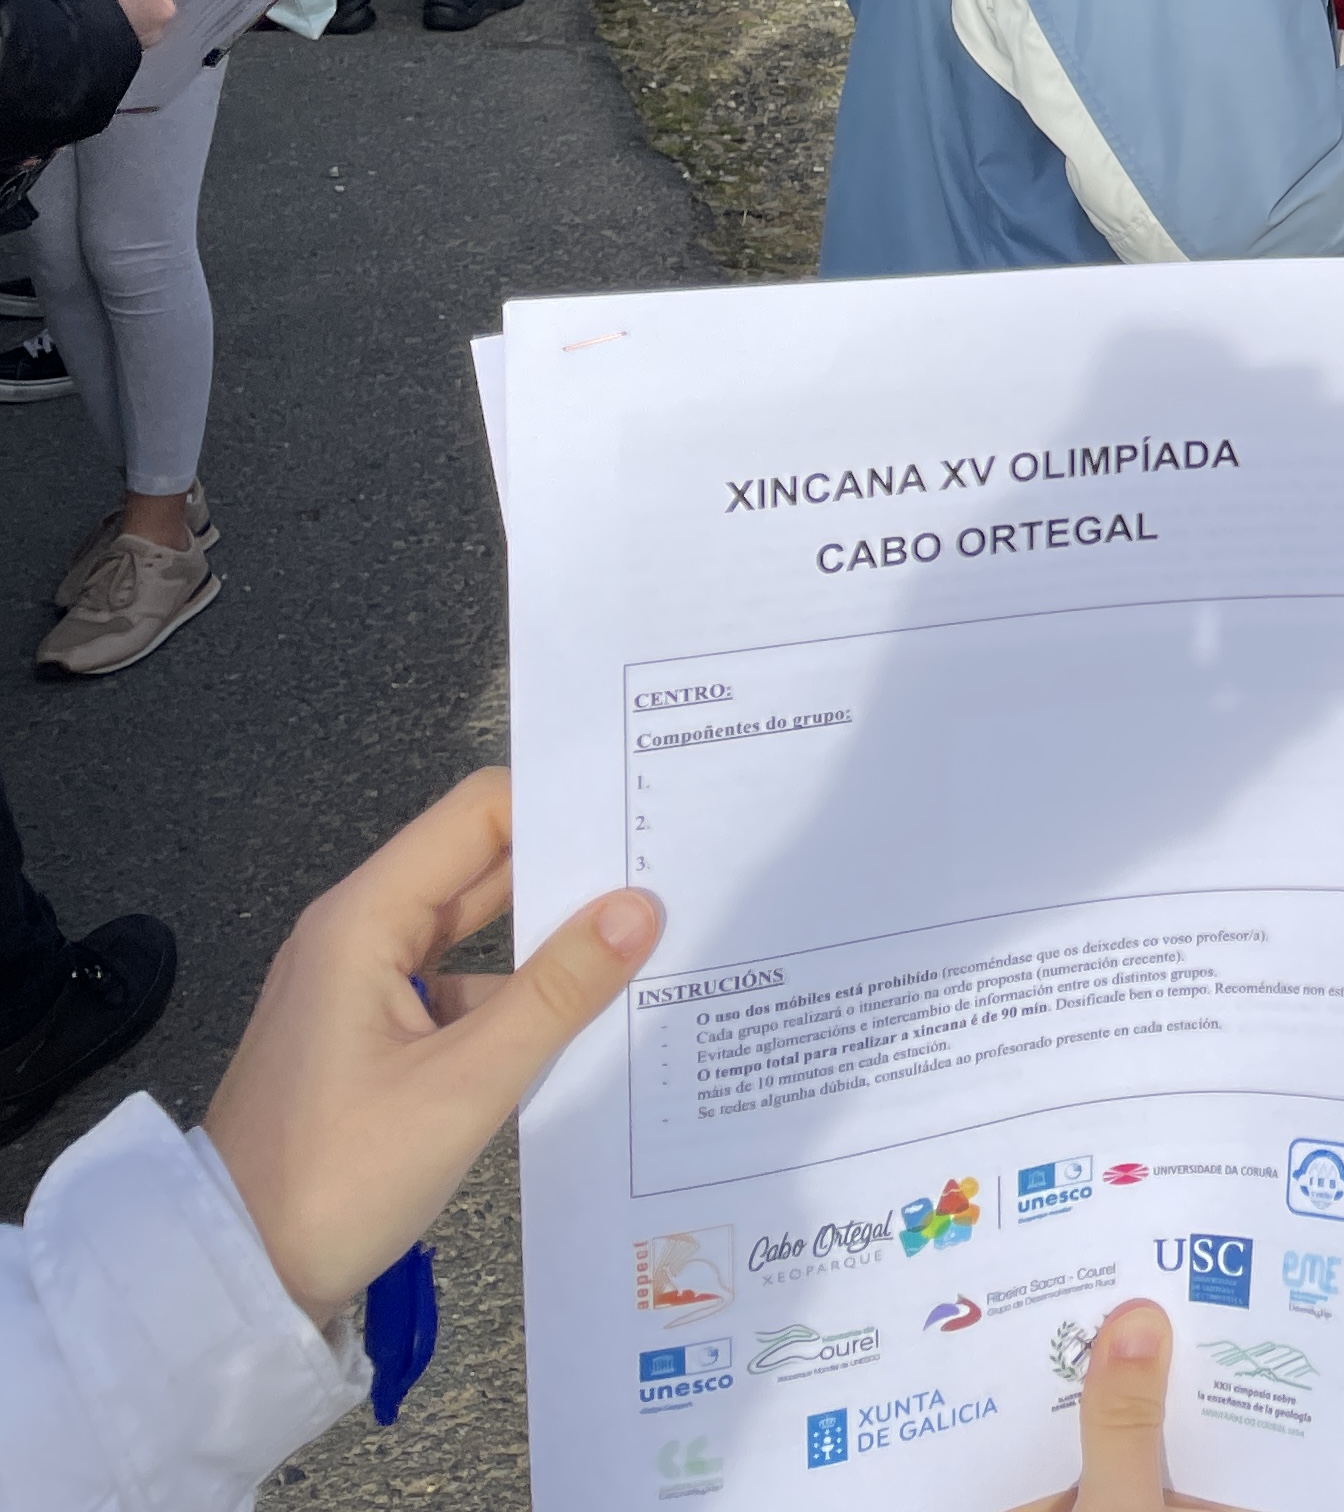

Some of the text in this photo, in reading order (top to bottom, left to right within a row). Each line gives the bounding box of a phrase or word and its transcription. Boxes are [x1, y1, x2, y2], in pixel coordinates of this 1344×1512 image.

[724, 435, 1240, 514] XINCANA XV OLIMPÍADA
[816, 512, 1159, 575] CABO ORTEGAL
[633, 683, 734, 710] CENTRO:
[636, 708, 852, 750] Compoñentes do grupo:
[637, 775, 650, 789] 1.
[635, 815, 651, 830] 2.
[636, 856, 651, 871] 3.
[638, 967, 784, 1006] INSTRUCIÓNS
[696, 929, 1269, 1025] O uso dos móbiles está prohibido (recoméndase que os deixedes co voso profesor/a).
[696, 951, 1185, 1044] Cada grupo realizará o itinerario na orde proposta (numeración crecente).
[697, 968, 1218, 1063] Evitade aglomeracións e intercambio de información entre os distintos grupos.
[696, 1068, 710, 1082] O
[715, 1062, 762, 1079] tempo
[766, 1051, 799, 1069] total
[803, 1046, 838, 1065] para
[842, 1033, 897, 1054] realizar
[900, 1032, 909, 1041] a
[913, 1018, 967, 1038] xincana
[970, 1014, 978, 1025] é
[981, 1011, 998, 1024] de
[1001, 1006, 1018, 1020] 90
[1055, 991, 1126, 1011] Dosificade
[1129, 988, 1151, 1001] ben
[1155, 990, 1164, 998] o
[1167, 987, 1211, 999] tempo.
[1214, 980, 1300, 995] Recoméndase
[1303, 986, 1325, 996] non
[697, 1106, 715, 1119] Se
[760, 1088, 816, 1108] algunha
[819, 1076, 870, 1096] dúbida,
[955, 1055, 972, 1065] ao
[975, 1035, 1053, 1064] profesorado
[1056, 1027, 1111, 1048] presente
[1113, 1026, 1130, 1037] en
[1133, 1020, 1163, 1034] cada
[1166, 1017, 1223, 1032] estación.
[697, 1039, 951, 1100] máis de 10 minutos en cada estación.
[1152, 1164, 1279, 1178] UNIVERSIDADE DA CORUÑA
[1017, 1186, 1093, 1213] unesco
[749, 1209, 894, 1272] Cabo Ortegal
[1153, 1238, 1245, 1276] USC
[762, 1249, 884, 1286] XEOPARQUE
[1077, 1261, 1116, 1280] Courel
[639, 1373, 734, 1403] unesco
[1253, 1402, 1264, 1413] de
[1272, 1394, 1297, 1405] sobre
[857, 1397, 999, 1453] DE GALICIA
[858, 1388, 946, 1428] XUNTA
